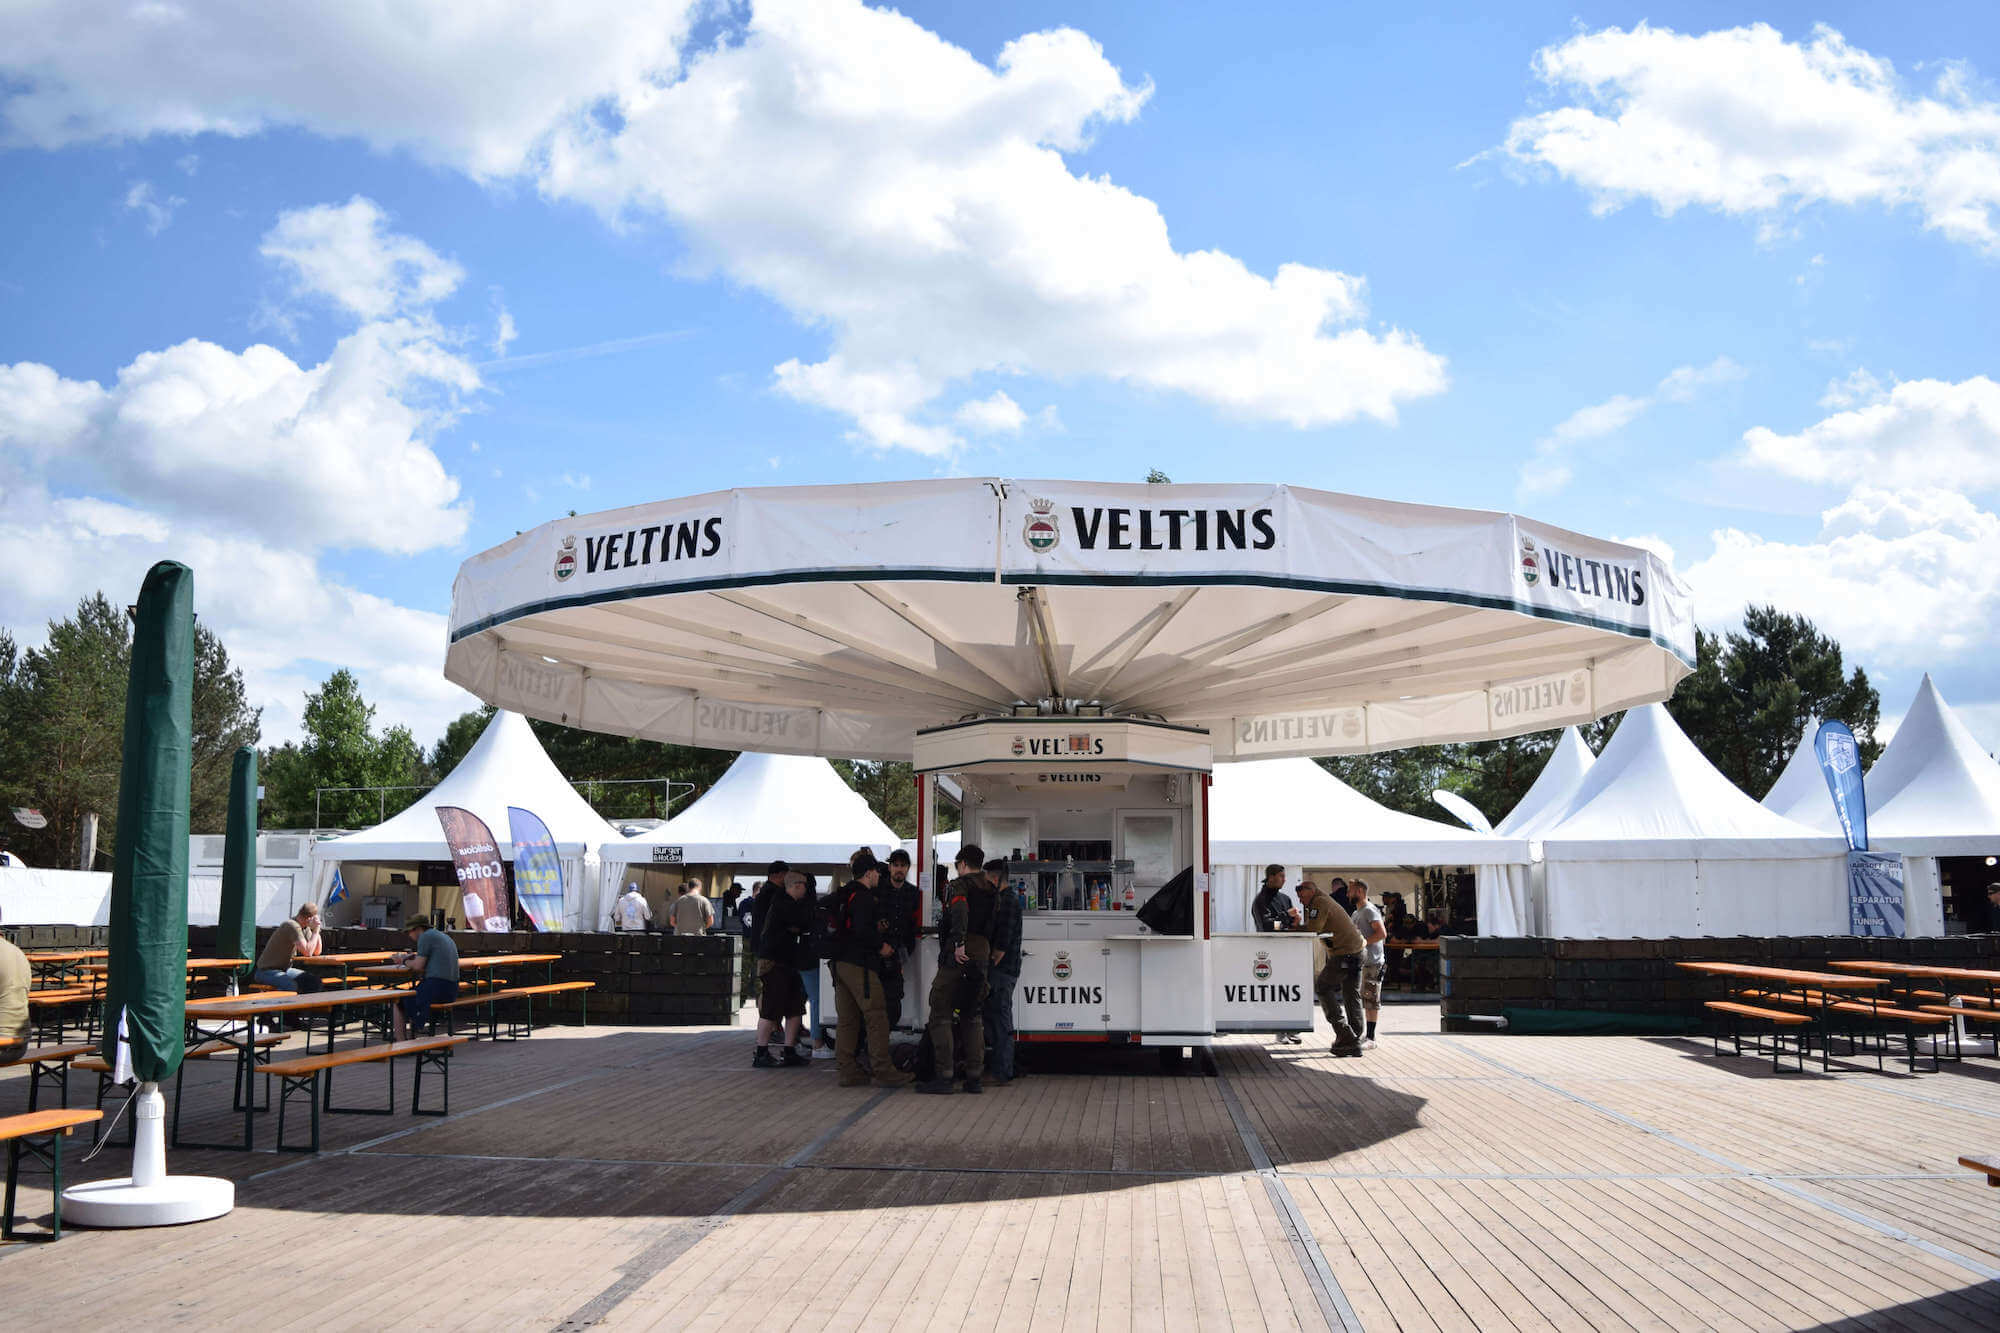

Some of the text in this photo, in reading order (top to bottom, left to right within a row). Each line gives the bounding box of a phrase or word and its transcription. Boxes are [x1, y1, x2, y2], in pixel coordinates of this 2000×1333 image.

[1071, 507, 1276, 551] VELTINS
[585, 517, 722, 573] VELTINS
[1543, 548, 1645, 606] VELTINS
[1029, 738, 1104, 755] VELS
[654, 847, 681, 855] Burger
[1852, 896, 1902, 904] REPARATUR
[1853, 918, 1885, 926] TUNING
[1023, 986, 1103, 1004] VELTINS
[1224, 985, 1301, 1002] VELTINS
